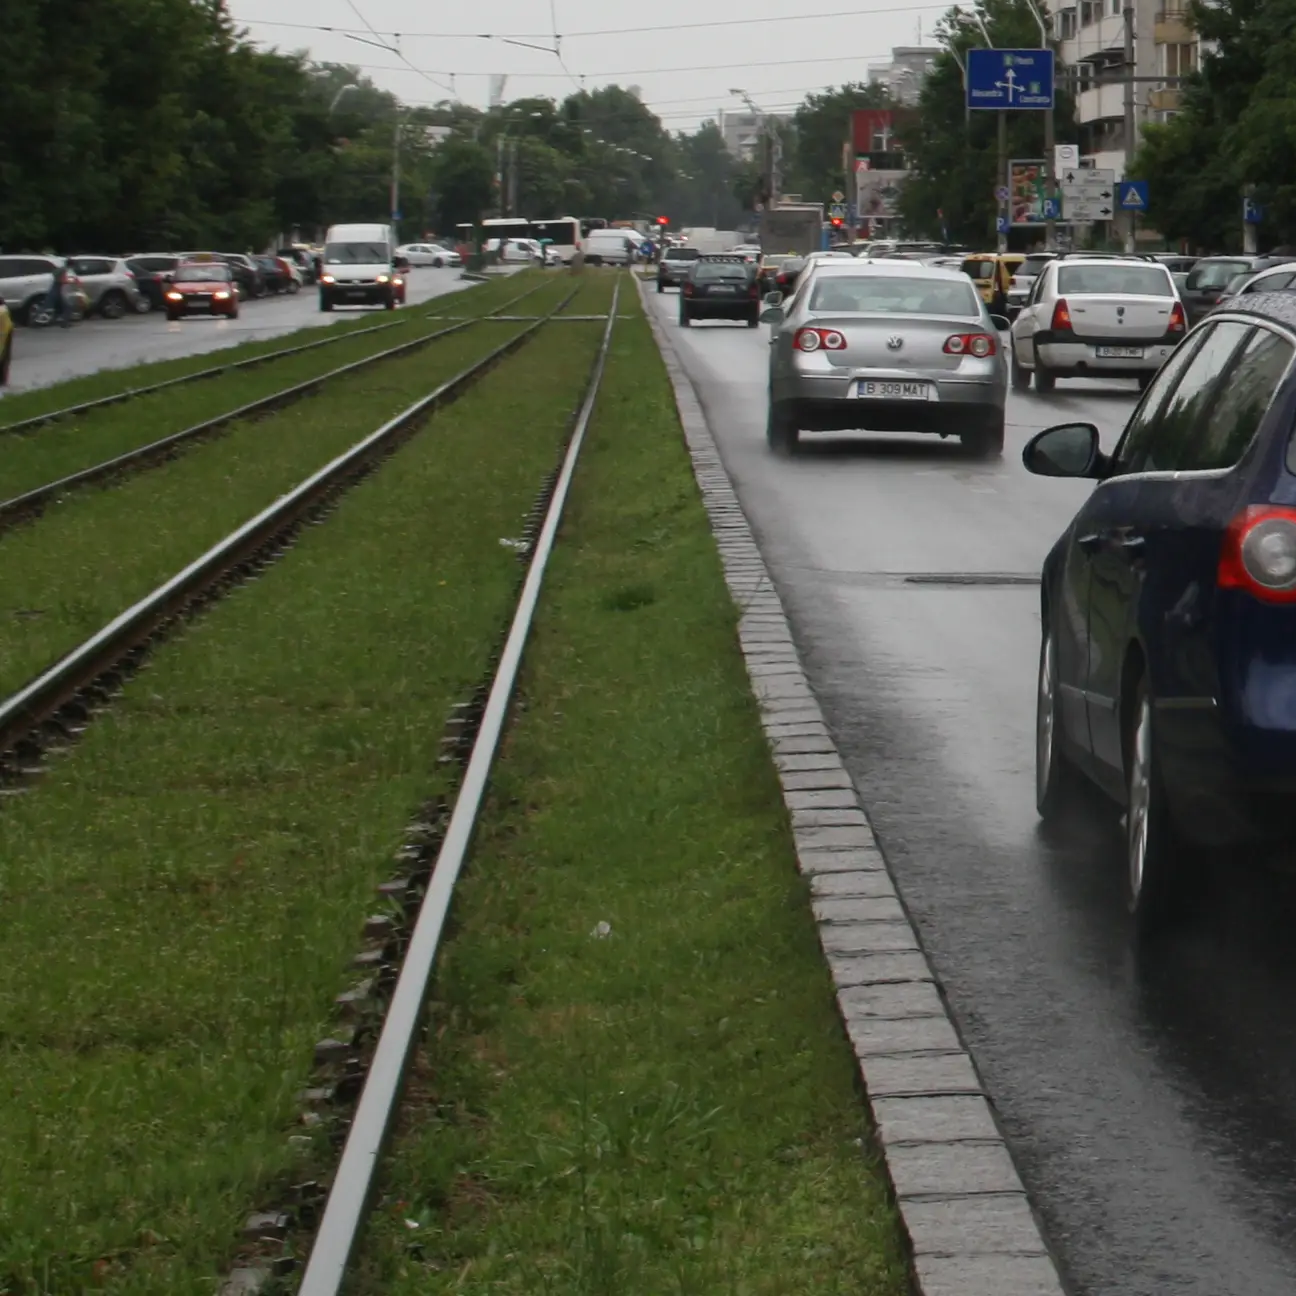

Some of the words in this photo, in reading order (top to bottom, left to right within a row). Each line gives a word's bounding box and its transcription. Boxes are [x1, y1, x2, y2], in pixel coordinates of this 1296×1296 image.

[867, 383, 876, 394] B
[880, 383, 900, 395] 309
[903, 383, 925, 396] MAT
